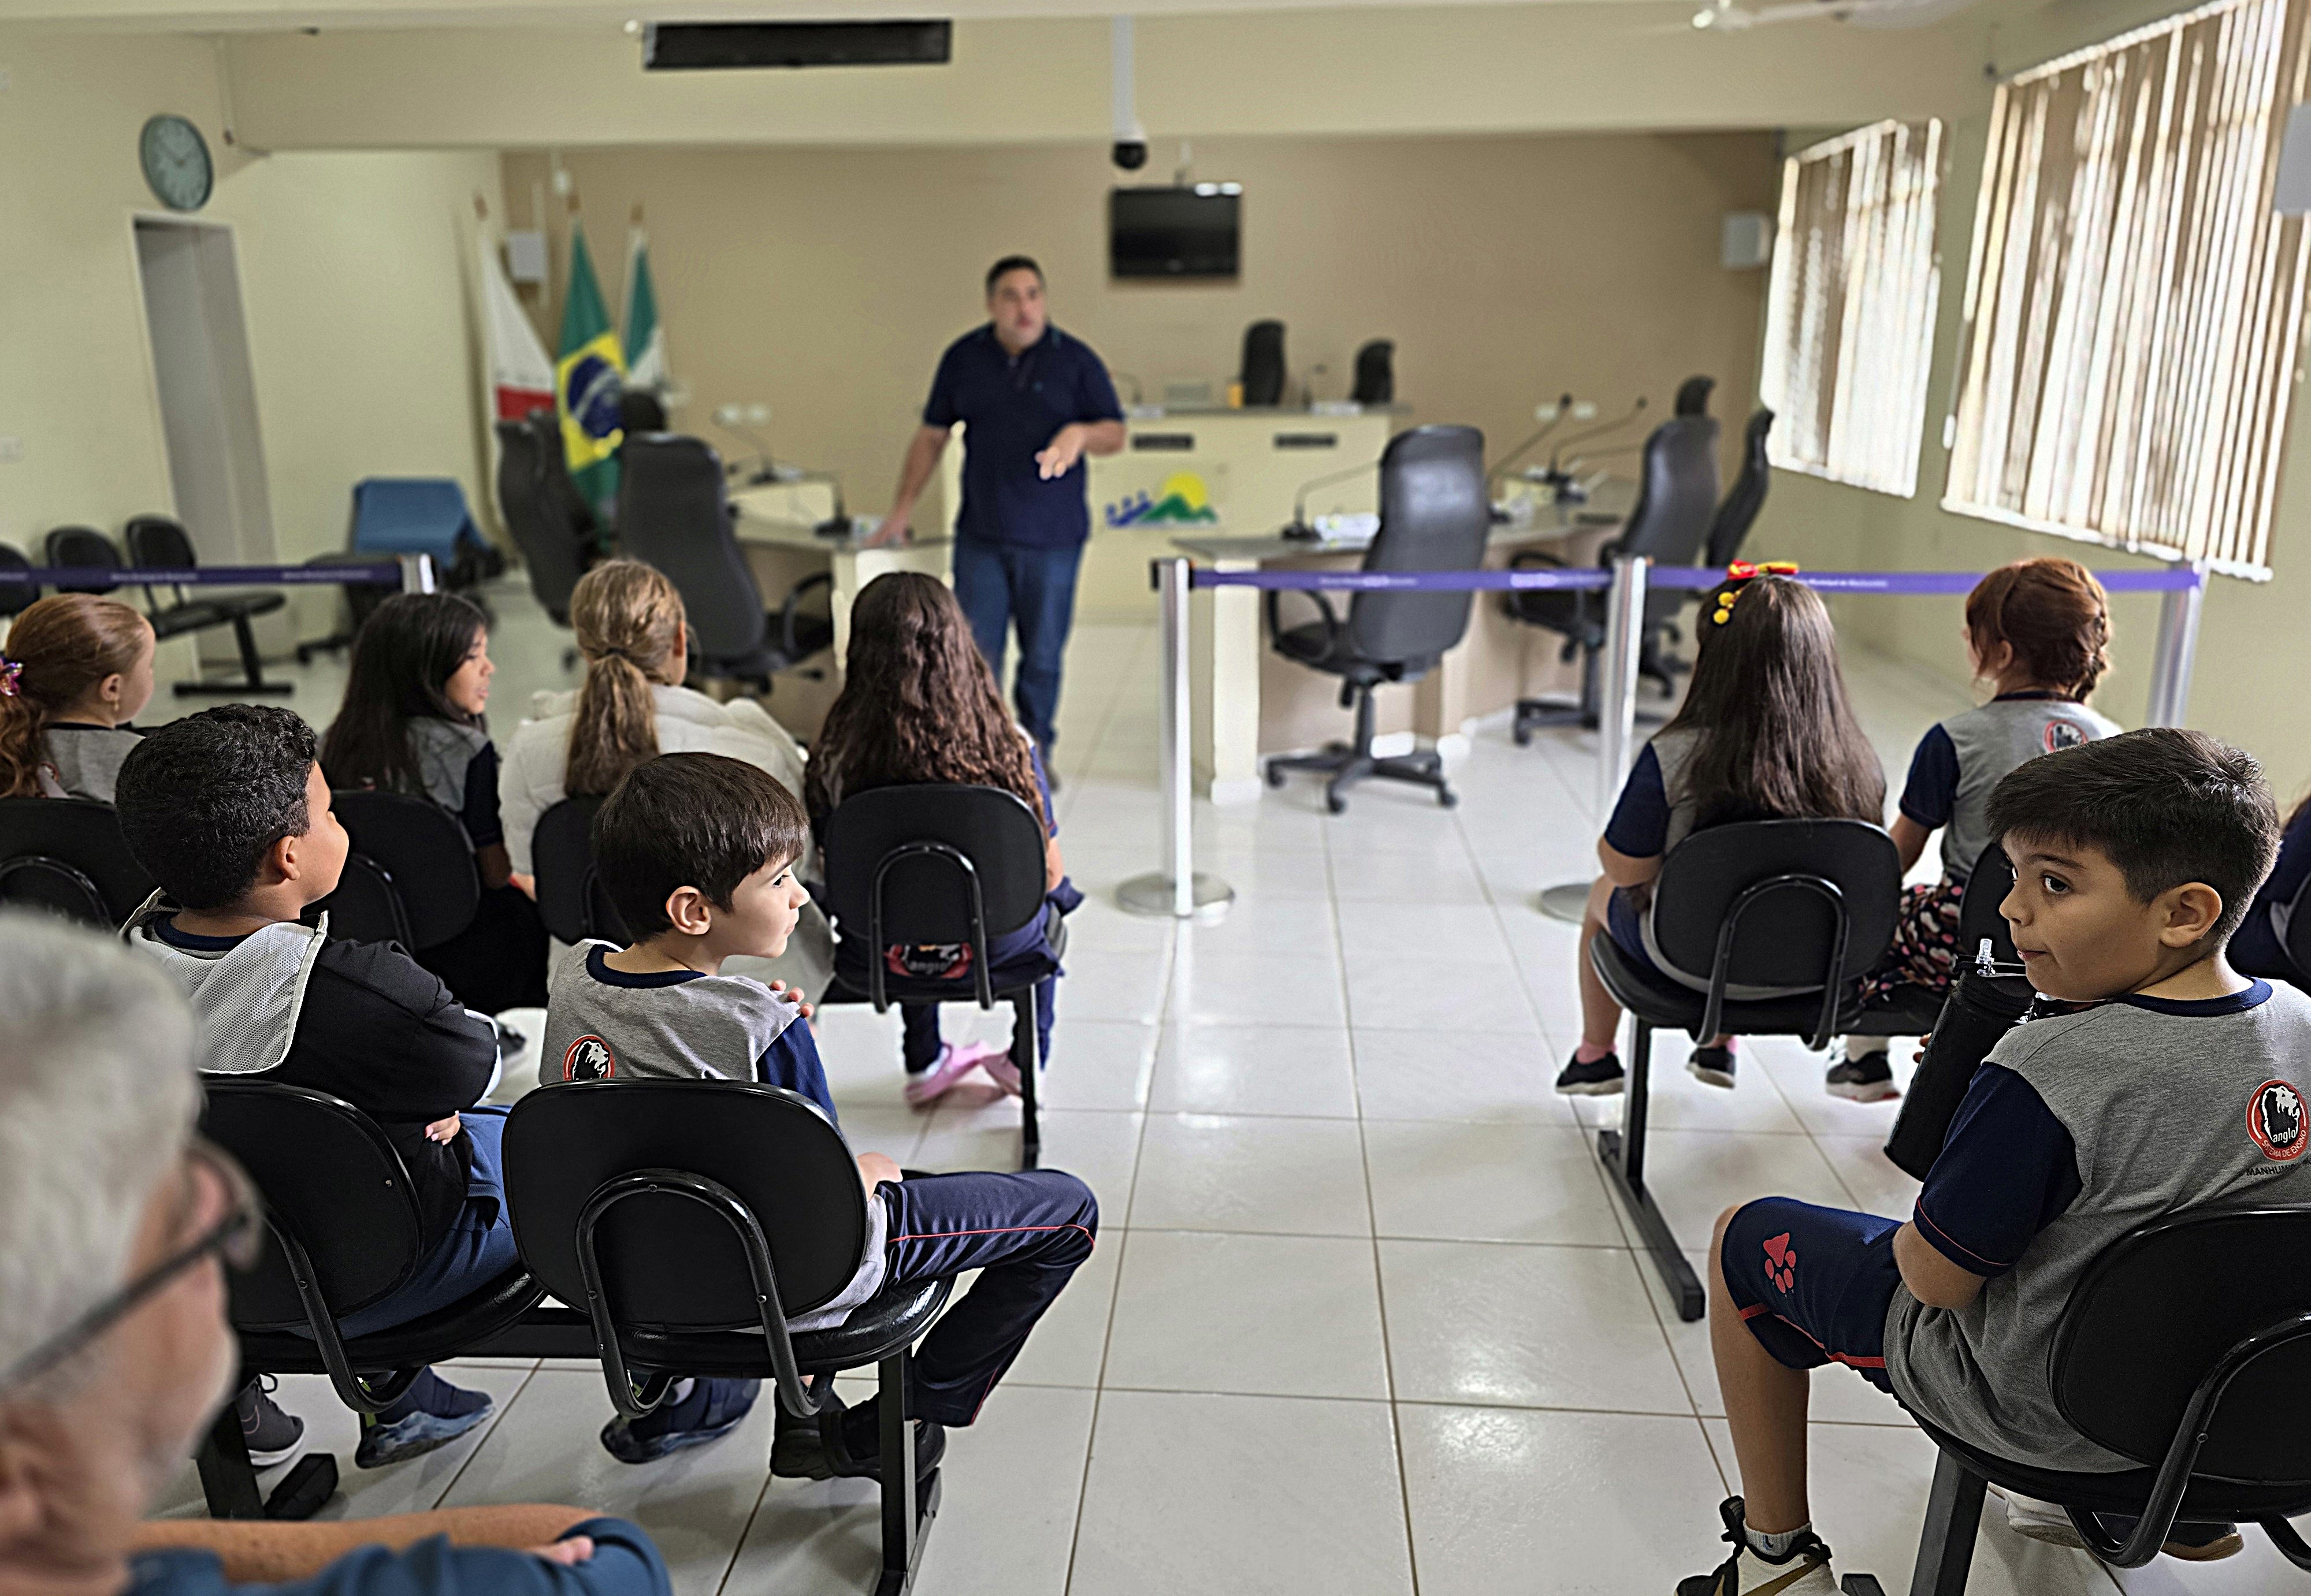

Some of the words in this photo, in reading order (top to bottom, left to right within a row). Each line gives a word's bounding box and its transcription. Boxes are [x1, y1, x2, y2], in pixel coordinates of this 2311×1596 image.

[909, 961, 948, 974] anglo
[2273, 1127, 2296, 1143] anglo
[2262, 1140, 2281, 1158] SISTEMA
[2282, 1148, 2292, 1158] DE
[2290, 1129, 2306, 1154] ENSINO
